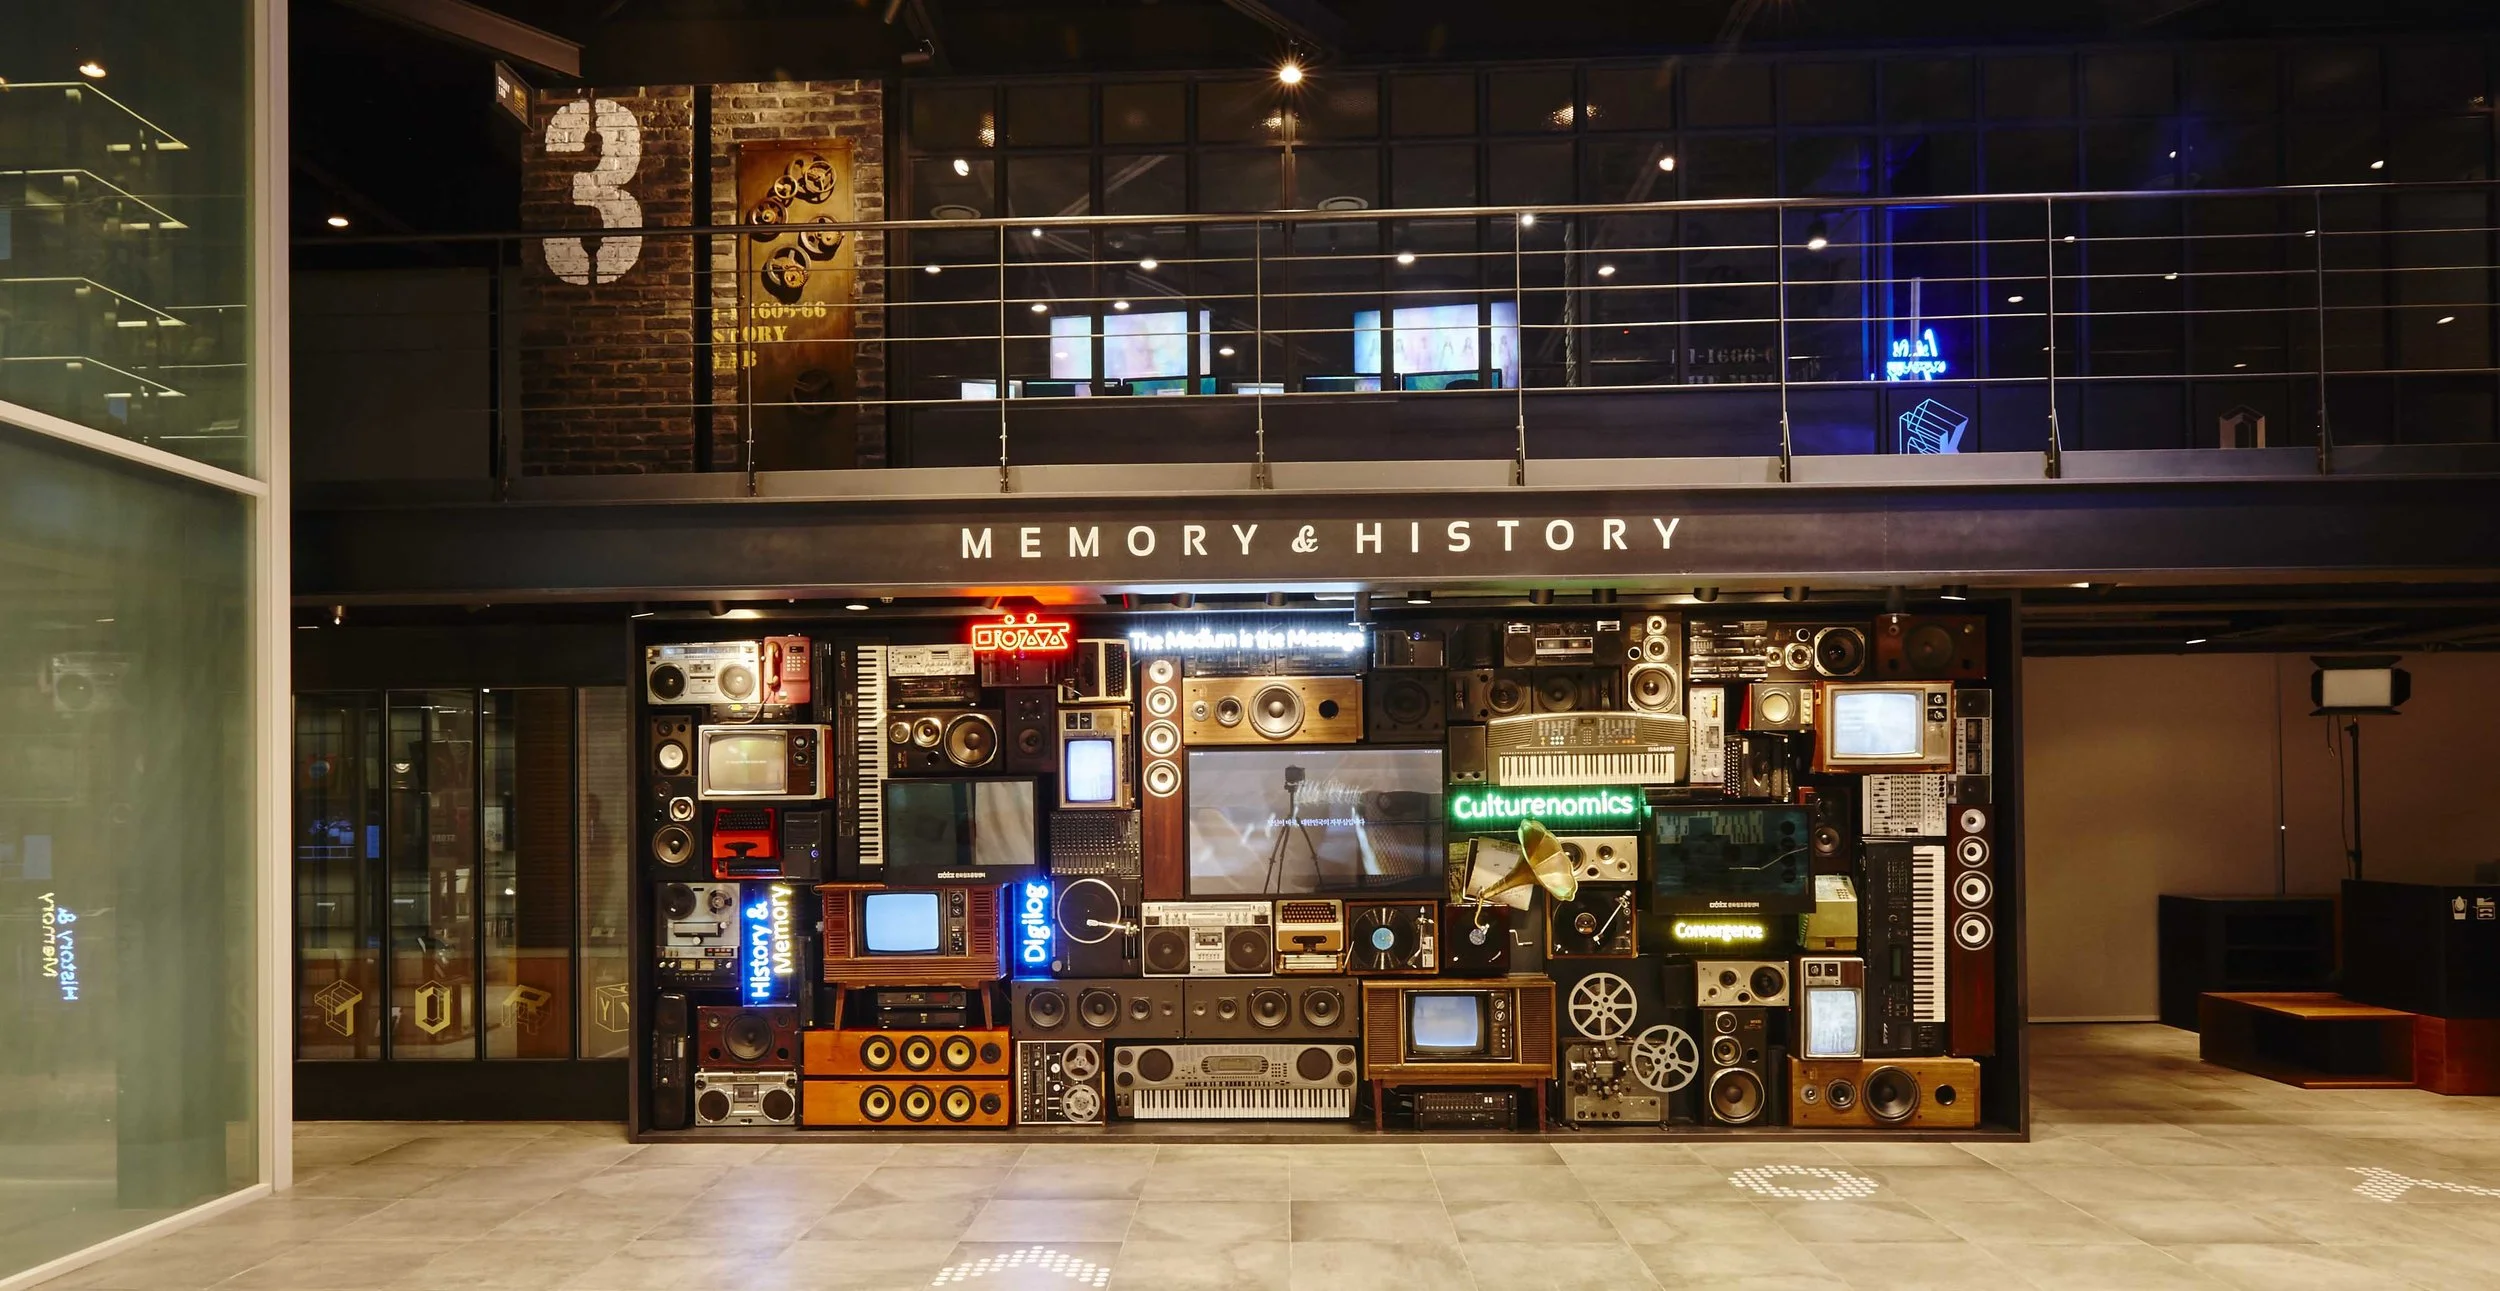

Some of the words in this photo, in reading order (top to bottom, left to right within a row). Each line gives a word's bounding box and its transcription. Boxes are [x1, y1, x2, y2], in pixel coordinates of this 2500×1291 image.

[542, 98, 643, 285] 3
[712, 325, 787, 343] STORY
[962, 525, 1260, 559] MEMORY
[1291, 526, 1318, 553] &
[1356, 518, 1681, 554] HISTORY
[1129, 631, 1163, 651] The
[1165, 628, 1237, 650] Medium
[1255, 629, 1286, 649] the
[1287, 628, 1366, 652] Message
[1454, 790, 1635, 819] Culturenomics
[745, 900, 770, 920] &
[1021, 882, 1051, 963] Digilog
[771, 885, 793, 974] Memory
[1674, 921, 1764, 942] Convergence
[749, 924, 773, 998] History
